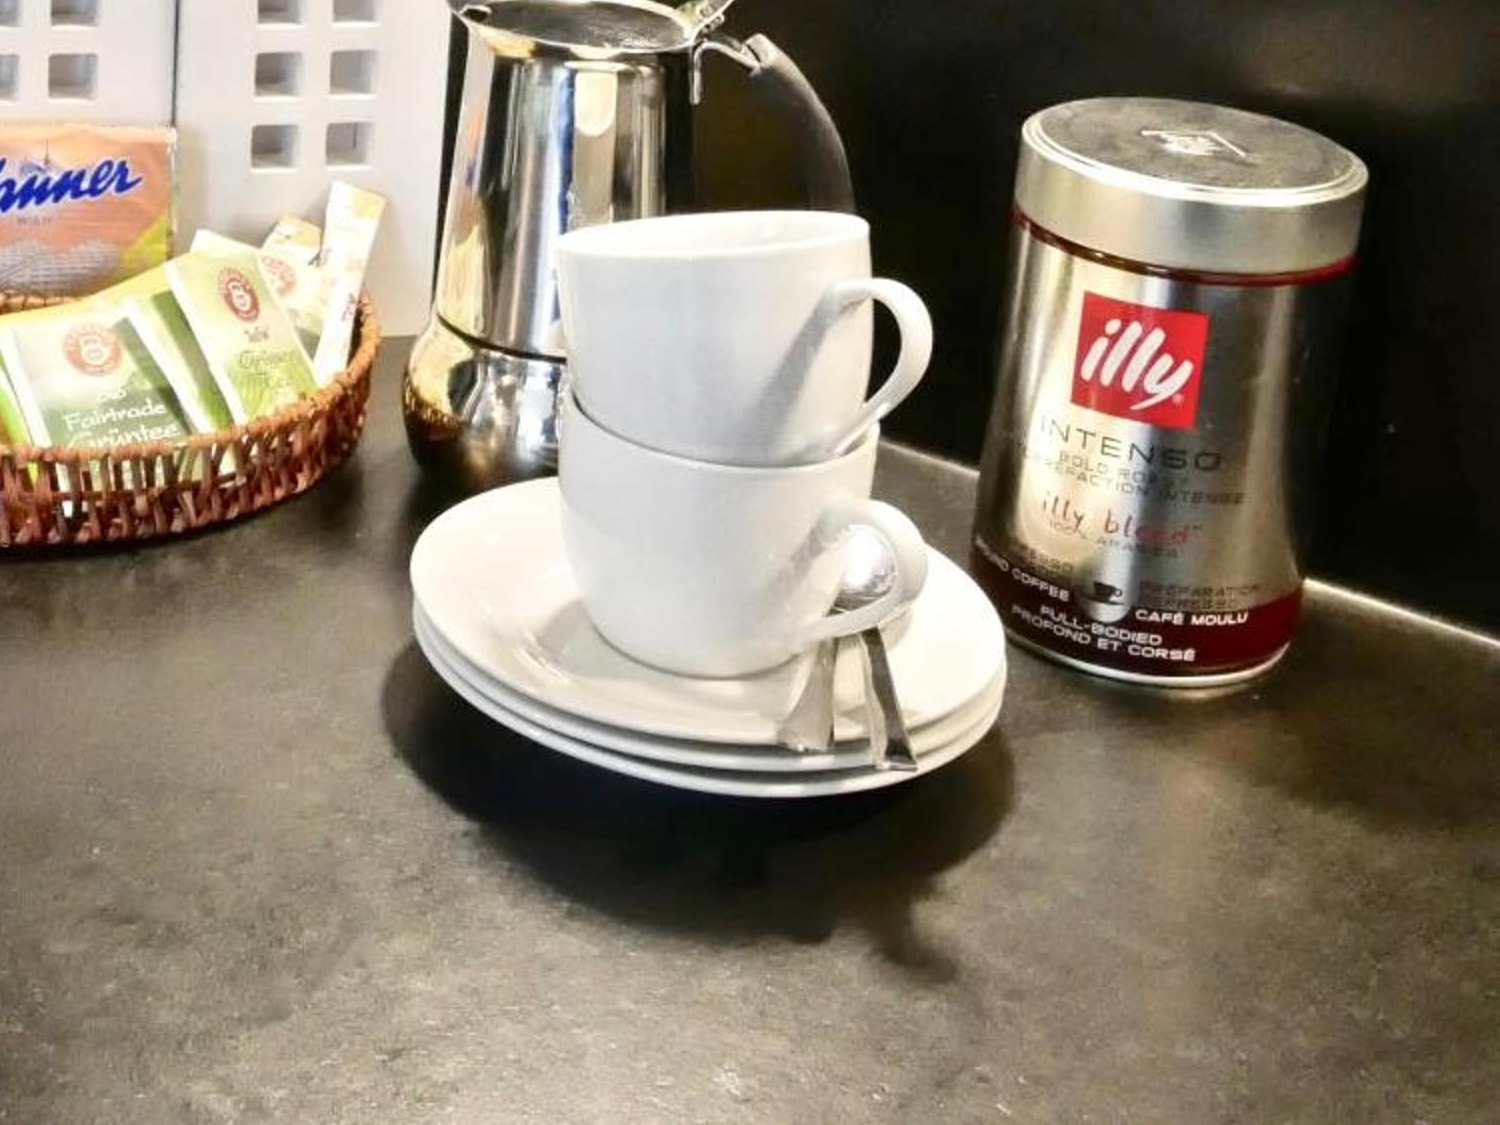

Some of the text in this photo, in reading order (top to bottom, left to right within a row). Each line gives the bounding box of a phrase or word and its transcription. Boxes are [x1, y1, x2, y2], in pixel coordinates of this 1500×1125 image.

[1080, 317, 1194, 410] illy
[62, 397, 166, 431] Fairtrade
[1040, 415, 1221, 472] INTENSO
[1043, 490, 1085, 530] illy
[1011, 568, 1070, 602] COFFEE
[1011, 604, 1197, 663] PROFOND ET CORSÉ
[1041, 604, 1163, 646] FULL-BODIED
[1135, 608, 1249, 626] CAFÉ MOULU
